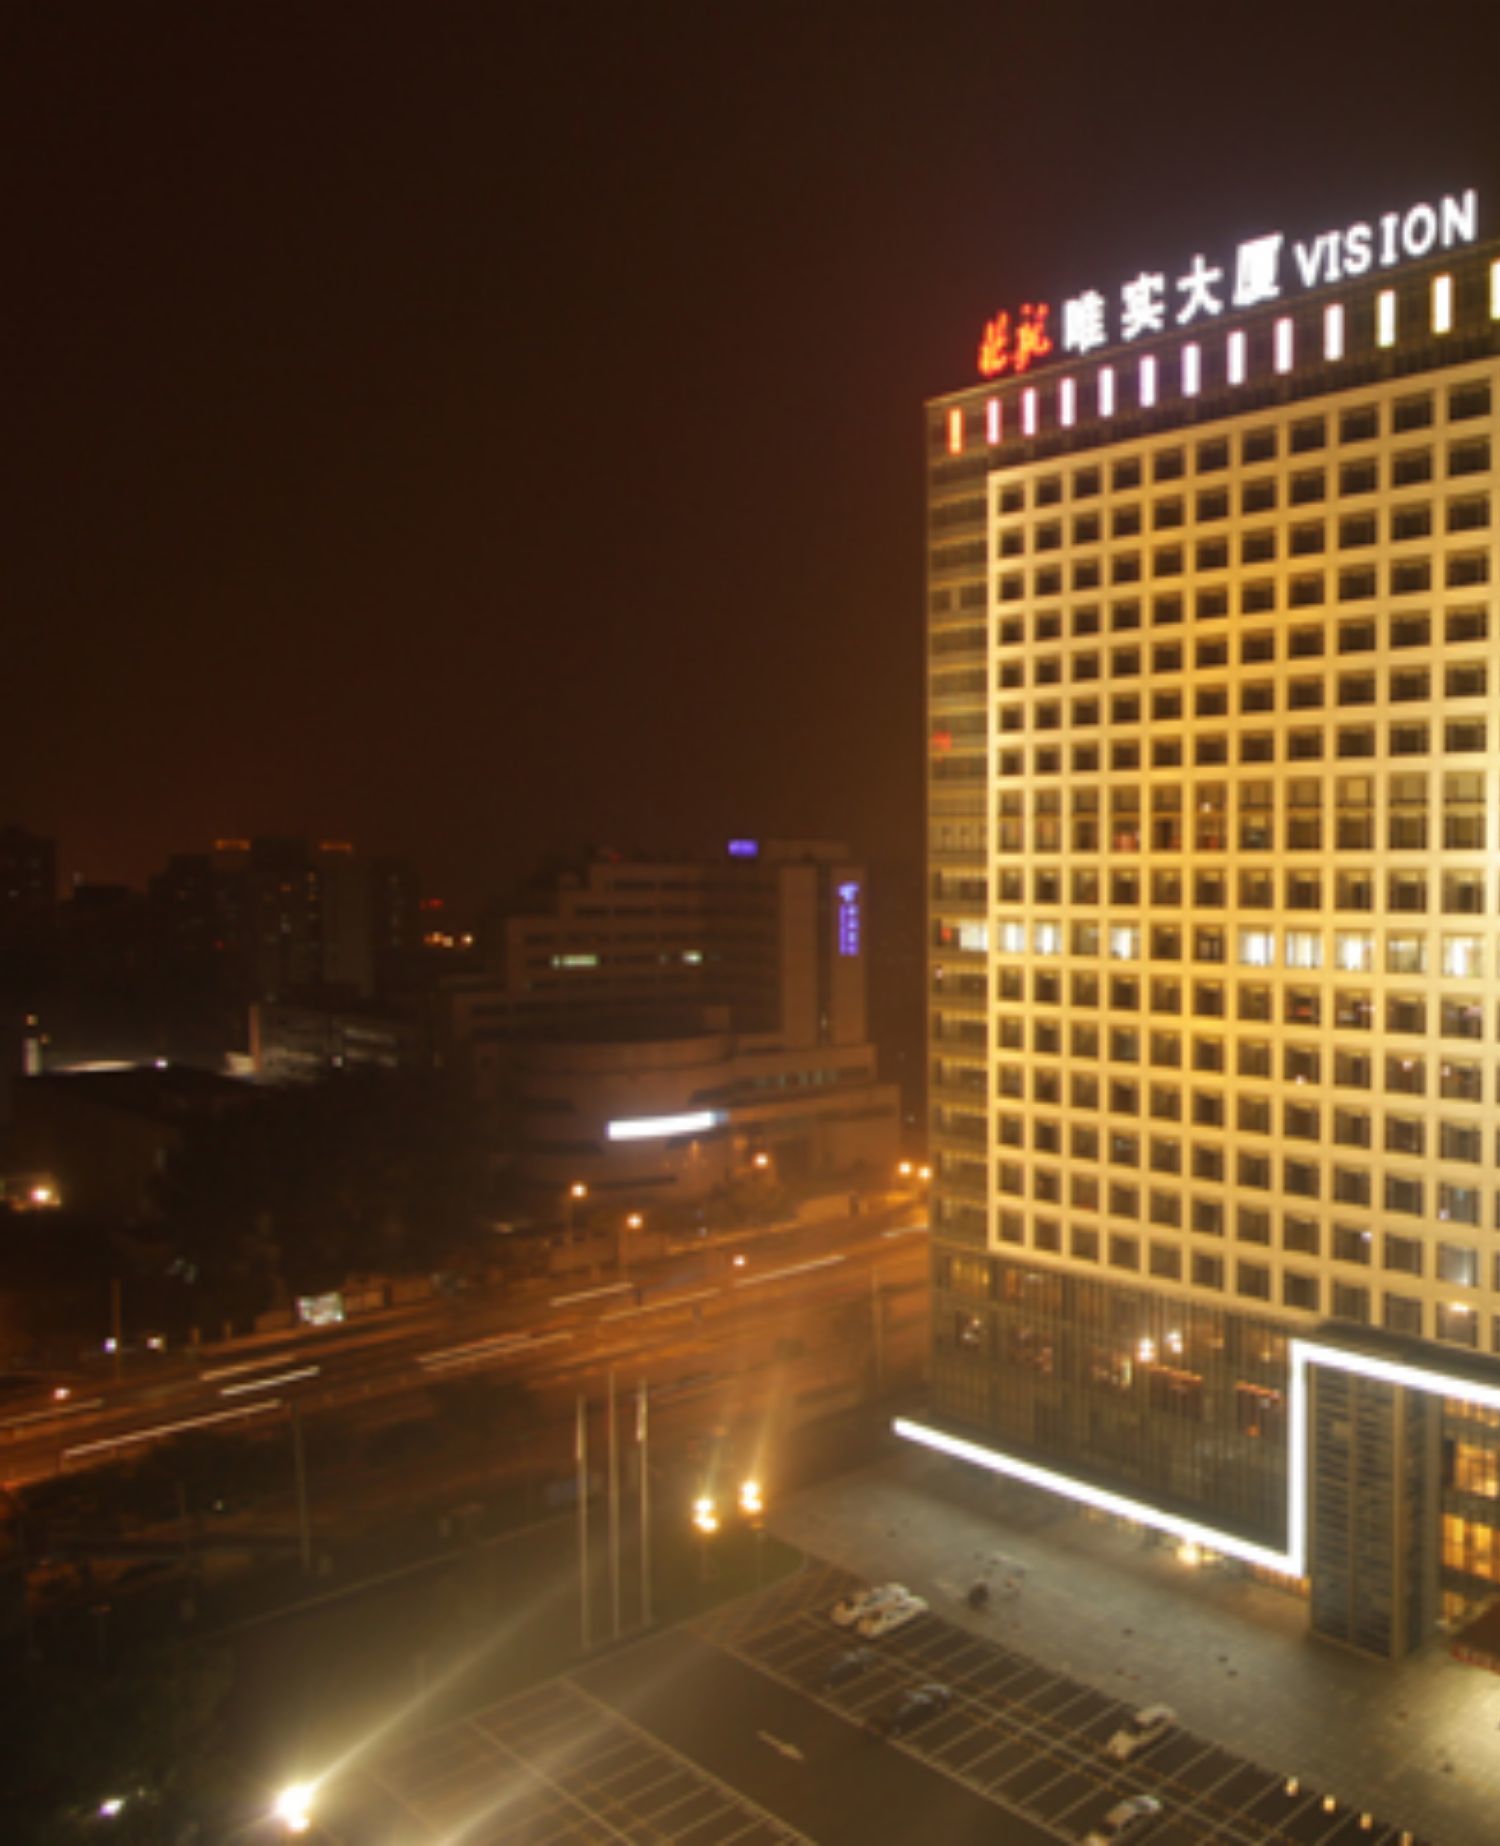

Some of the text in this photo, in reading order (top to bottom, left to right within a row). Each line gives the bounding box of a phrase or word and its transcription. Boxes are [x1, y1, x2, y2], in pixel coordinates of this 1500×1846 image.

[1062, 231, 1284, 354] 唯实大厦
[1292, 188, 1477, 288] VISION
